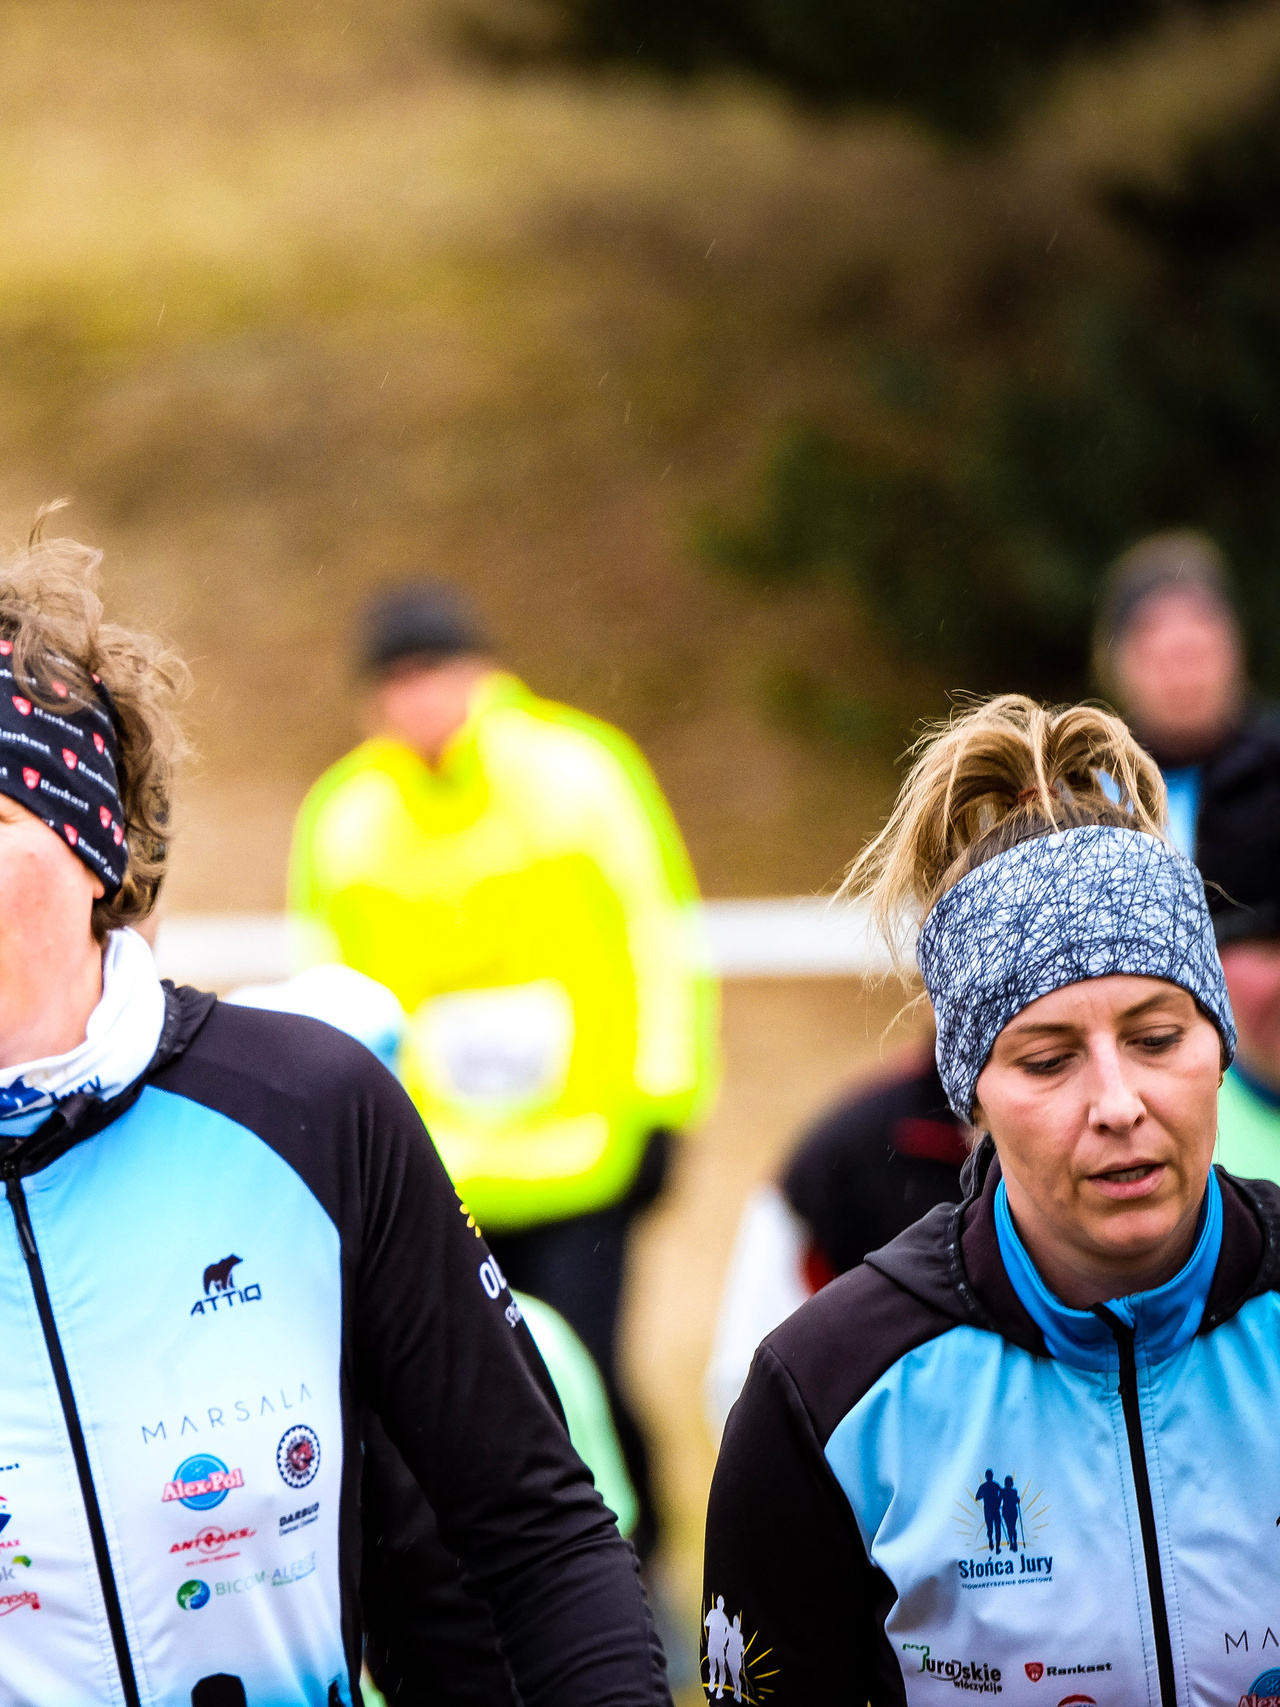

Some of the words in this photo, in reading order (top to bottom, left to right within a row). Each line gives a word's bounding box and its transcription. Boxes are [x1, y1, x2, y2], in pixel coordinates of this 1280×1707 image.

[141, 1382, 313, 1444] MARSALA
[958, 1556, 1014, 1579] Słońca
[1019, 1553, 1053, 1575] Jury
[1046, 1661, 1113, 1677] Rankast
